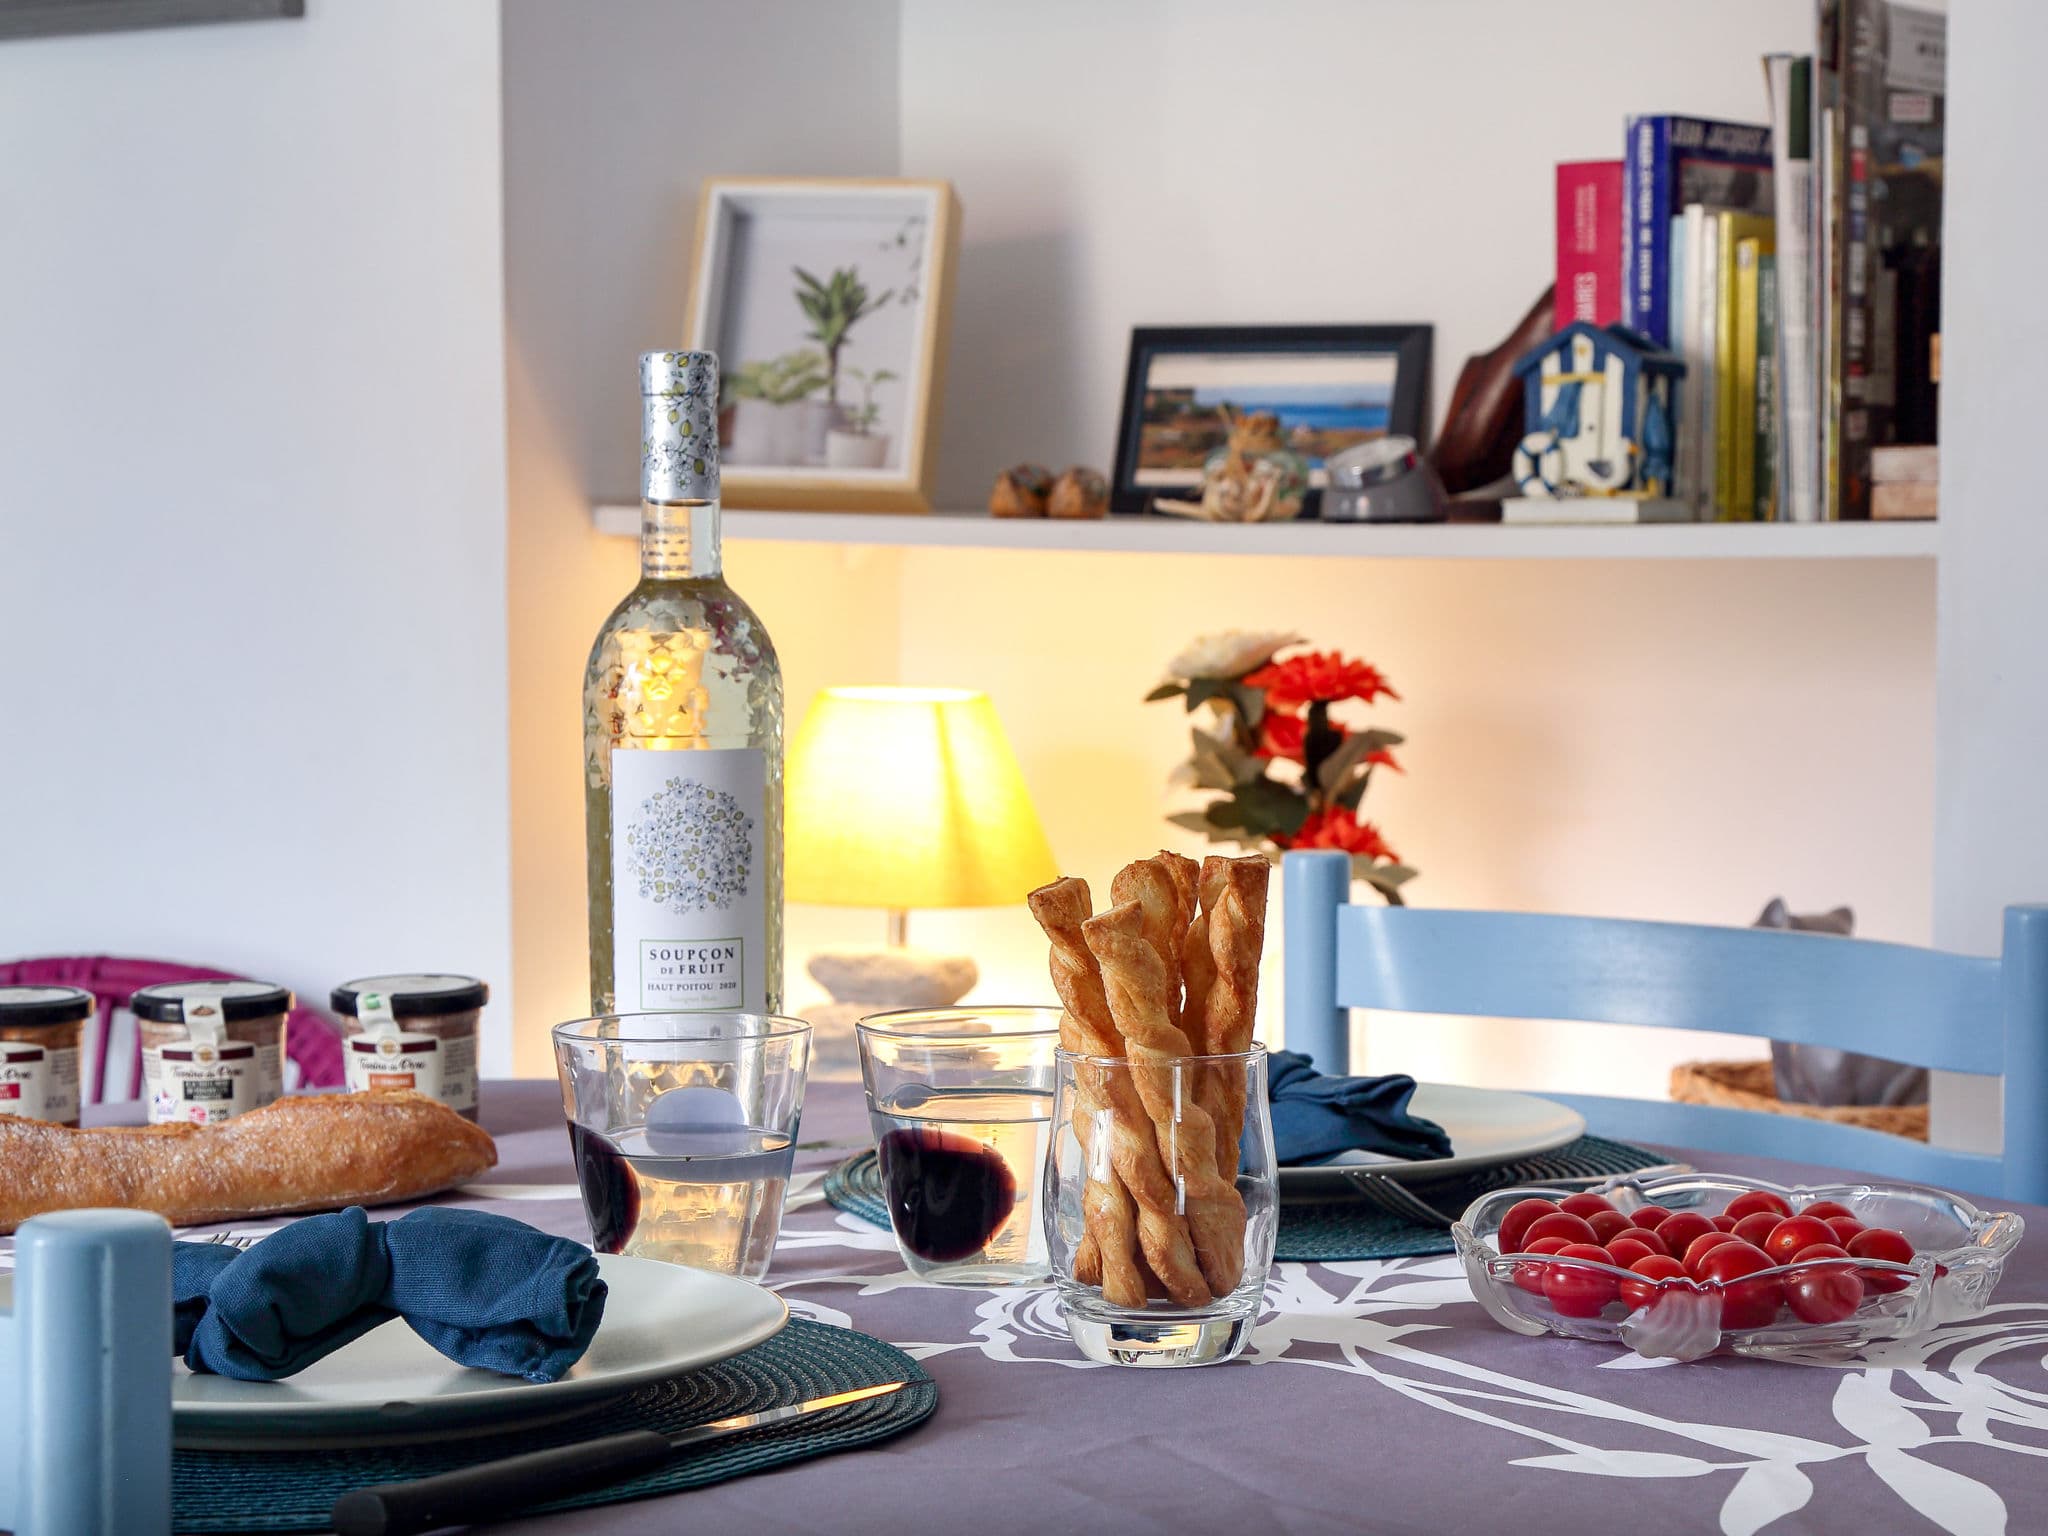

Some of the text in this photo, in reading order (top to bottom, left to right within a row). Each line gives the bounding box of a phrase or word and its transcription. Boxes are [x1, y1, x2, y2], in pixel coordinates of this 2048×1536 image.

[650, 947, 734, 963] SOUPÇON
[660, 963, 725, 975] DE FRUIT
[647, 983, 674, 991] HAUT
[676, 983, 713, 991] POITOU
